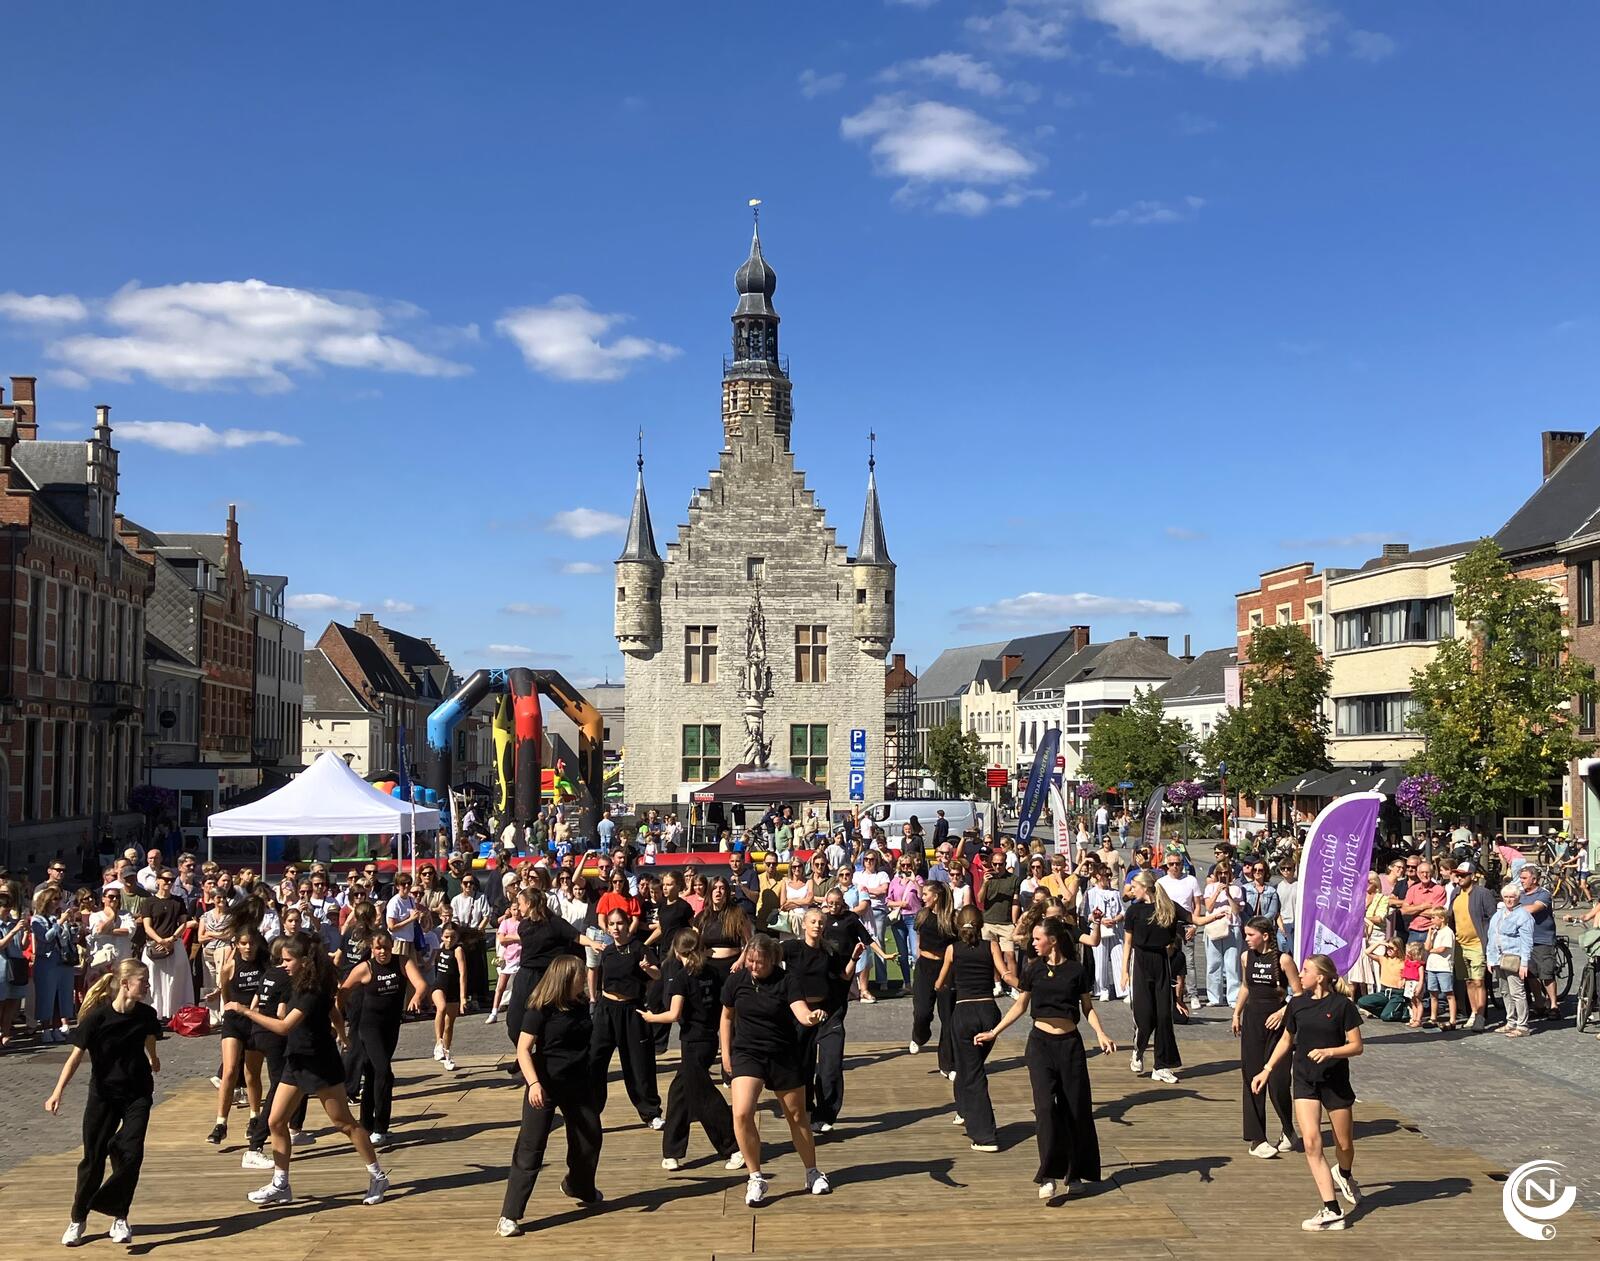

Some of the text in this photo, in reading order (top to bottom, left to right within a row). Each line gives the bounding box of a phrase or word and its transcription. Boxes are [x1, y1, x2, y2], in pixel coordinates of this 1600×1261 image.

[853, 731, 863, 743] P
[851, 773, 863, 790] P
[1315, 833, 1338, 910] Dansclub
[1336, 833, 1361, 913] Libalforte
